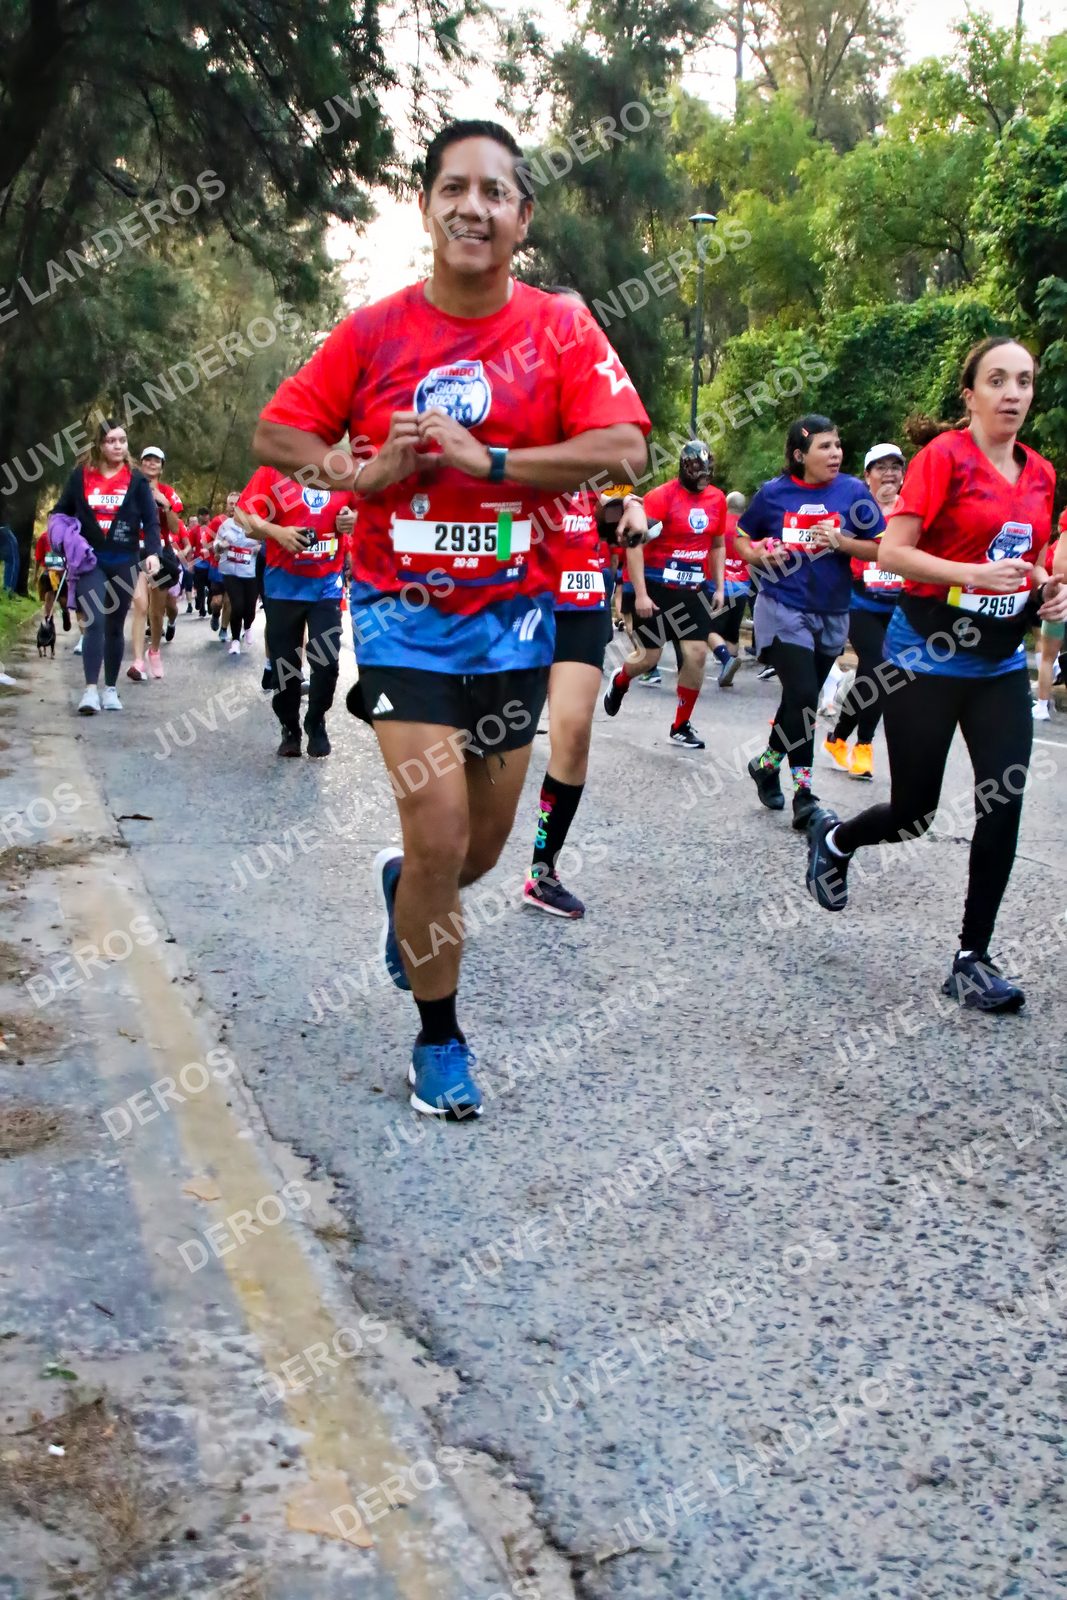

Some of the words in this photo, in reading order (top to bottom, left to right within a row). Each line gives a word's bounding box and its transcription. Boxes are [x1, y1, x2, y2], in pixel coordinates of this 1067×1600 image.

[434, 381, 473, 395] Global
[101, 495, 119, 504] 2562
[434, 524, 498, 552] 2935
[567, 573, 595, 590] 2981
[977, 595, 1016, 616] 2959
